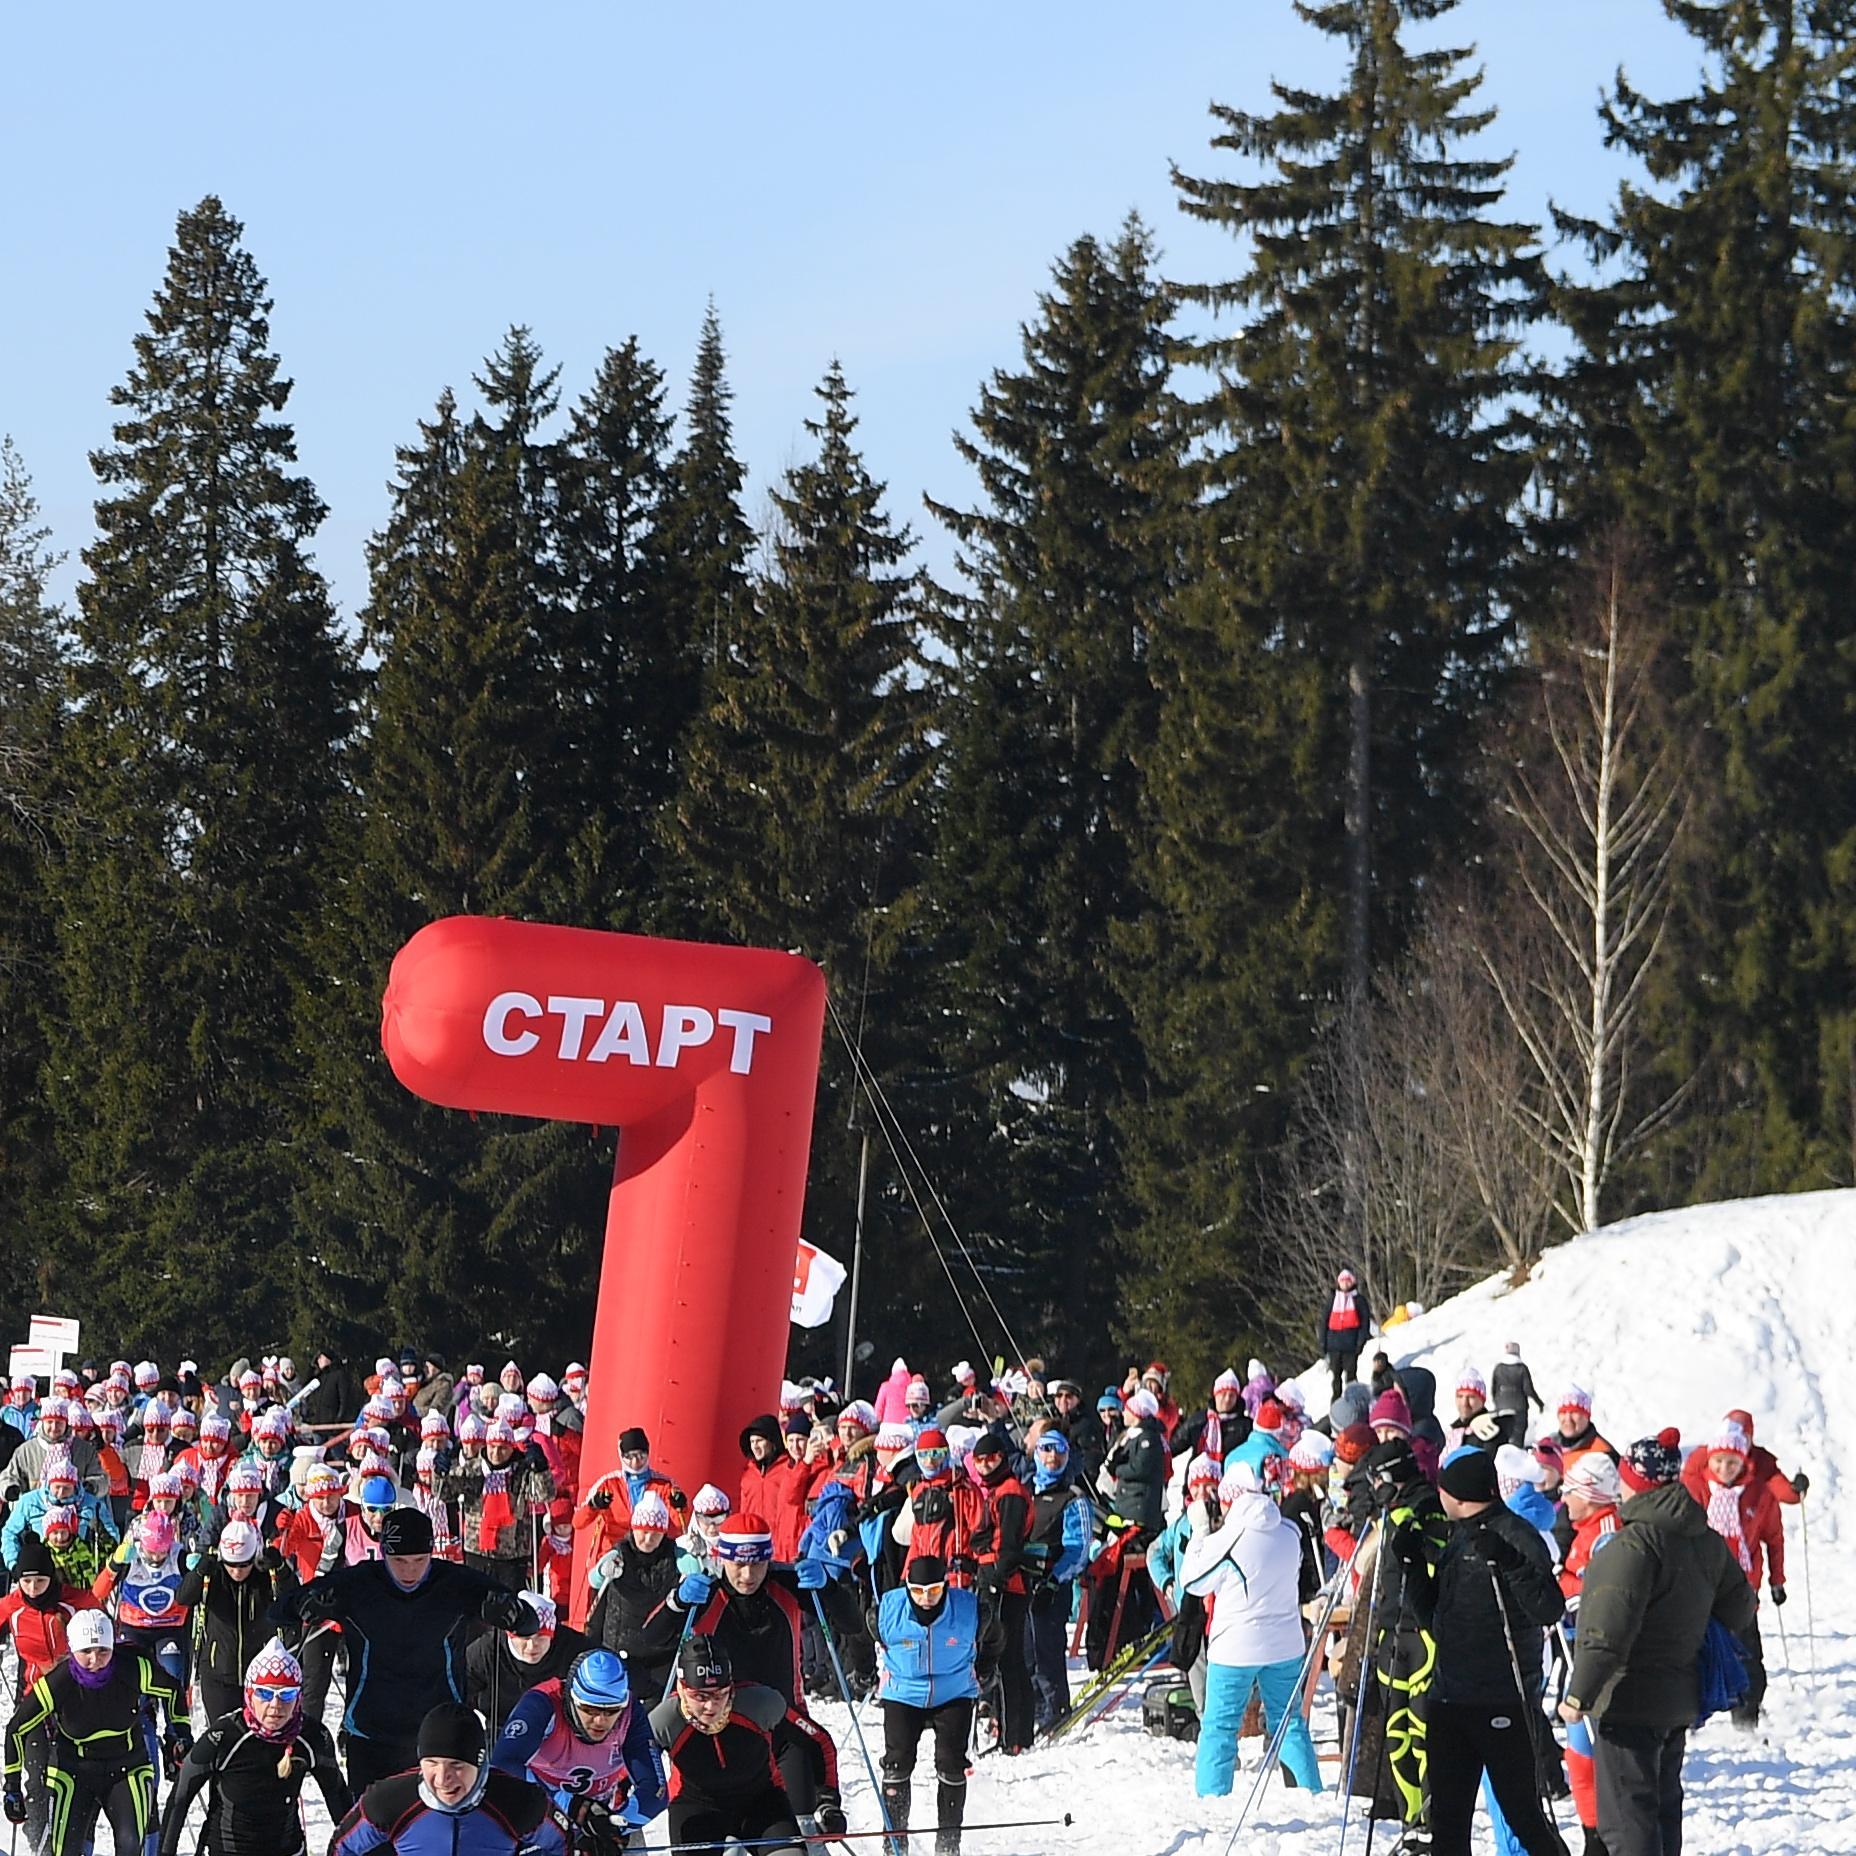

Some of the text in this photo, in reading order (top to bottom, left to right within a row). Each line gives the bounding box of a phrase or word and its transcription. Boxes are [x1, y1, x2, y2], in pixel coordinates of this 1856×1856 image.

[483, 991, 772, 1075] СТАРТ
[696, 1660, 722, 1679] DNB
[559, 1765, 597, 1795] 3
